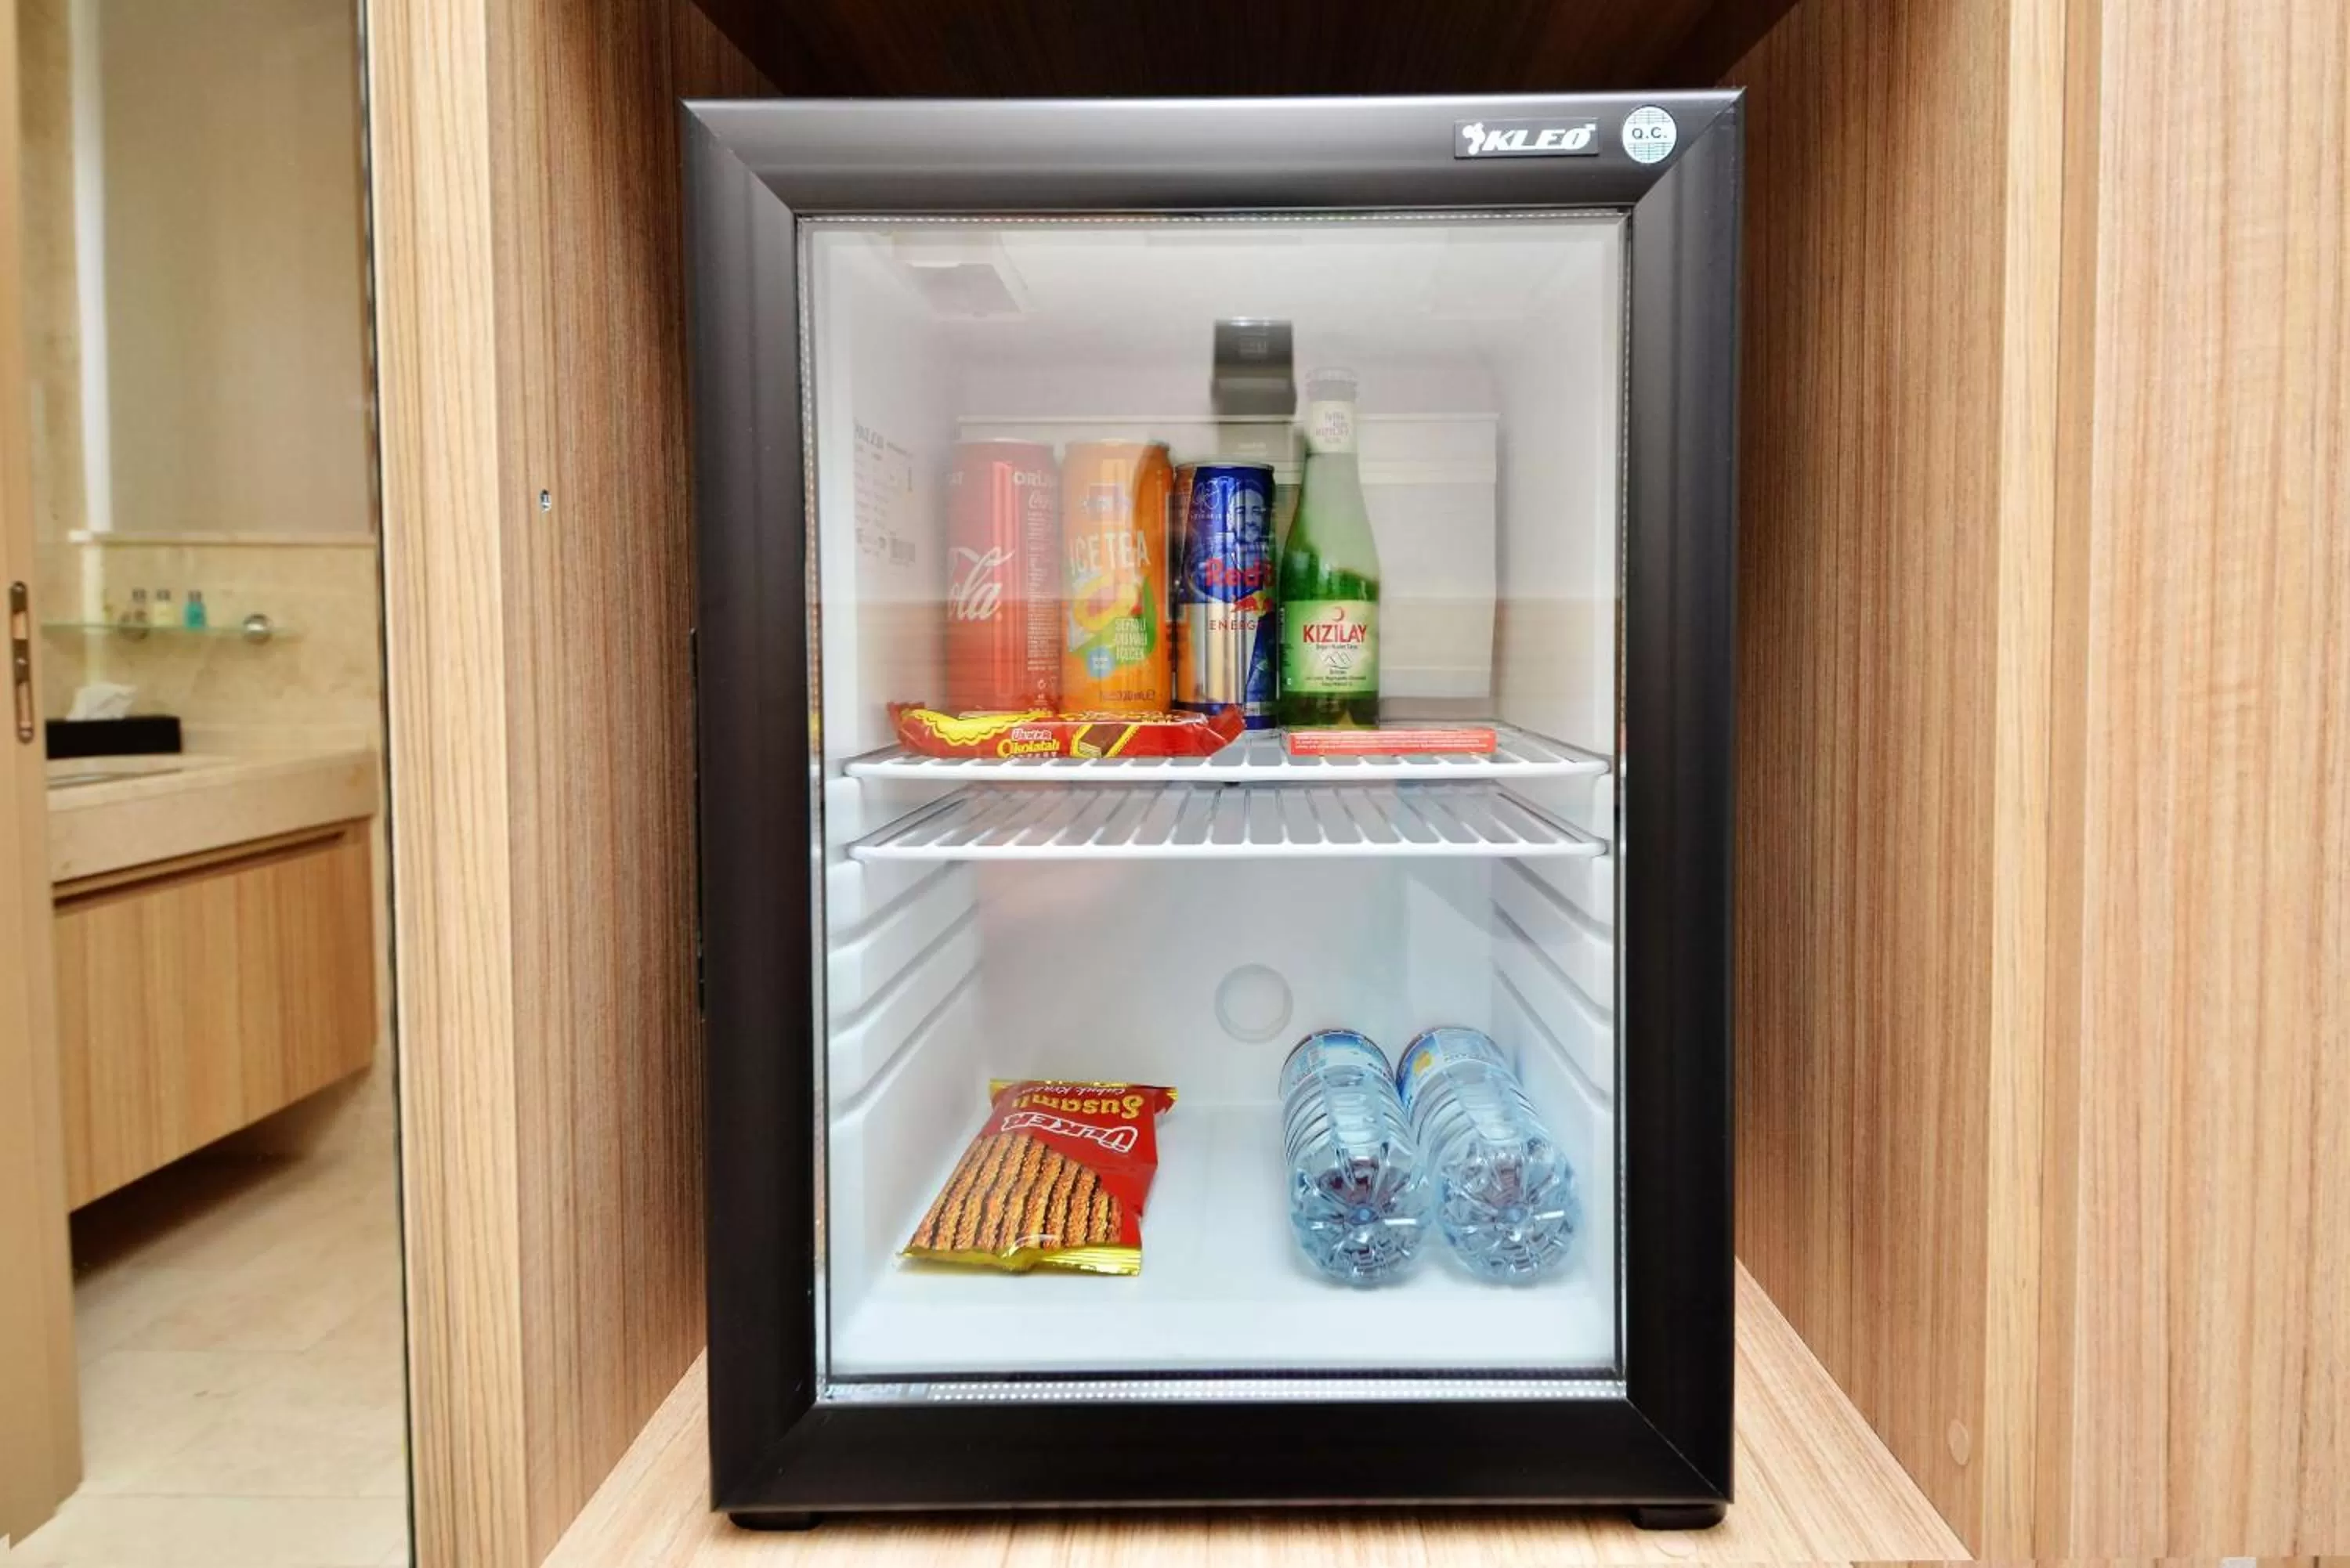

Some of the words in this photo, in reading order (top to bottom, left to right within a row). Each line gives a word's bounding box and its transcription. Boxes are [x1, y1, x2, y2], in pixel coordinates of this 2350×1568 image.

[1104, 529, 1152, 571] TEA
[1205, 556, 1261, 587] Red
[1209, 620, 1264, 631] ENERG
[1303, 623, 1368, 643] KIZILAY
